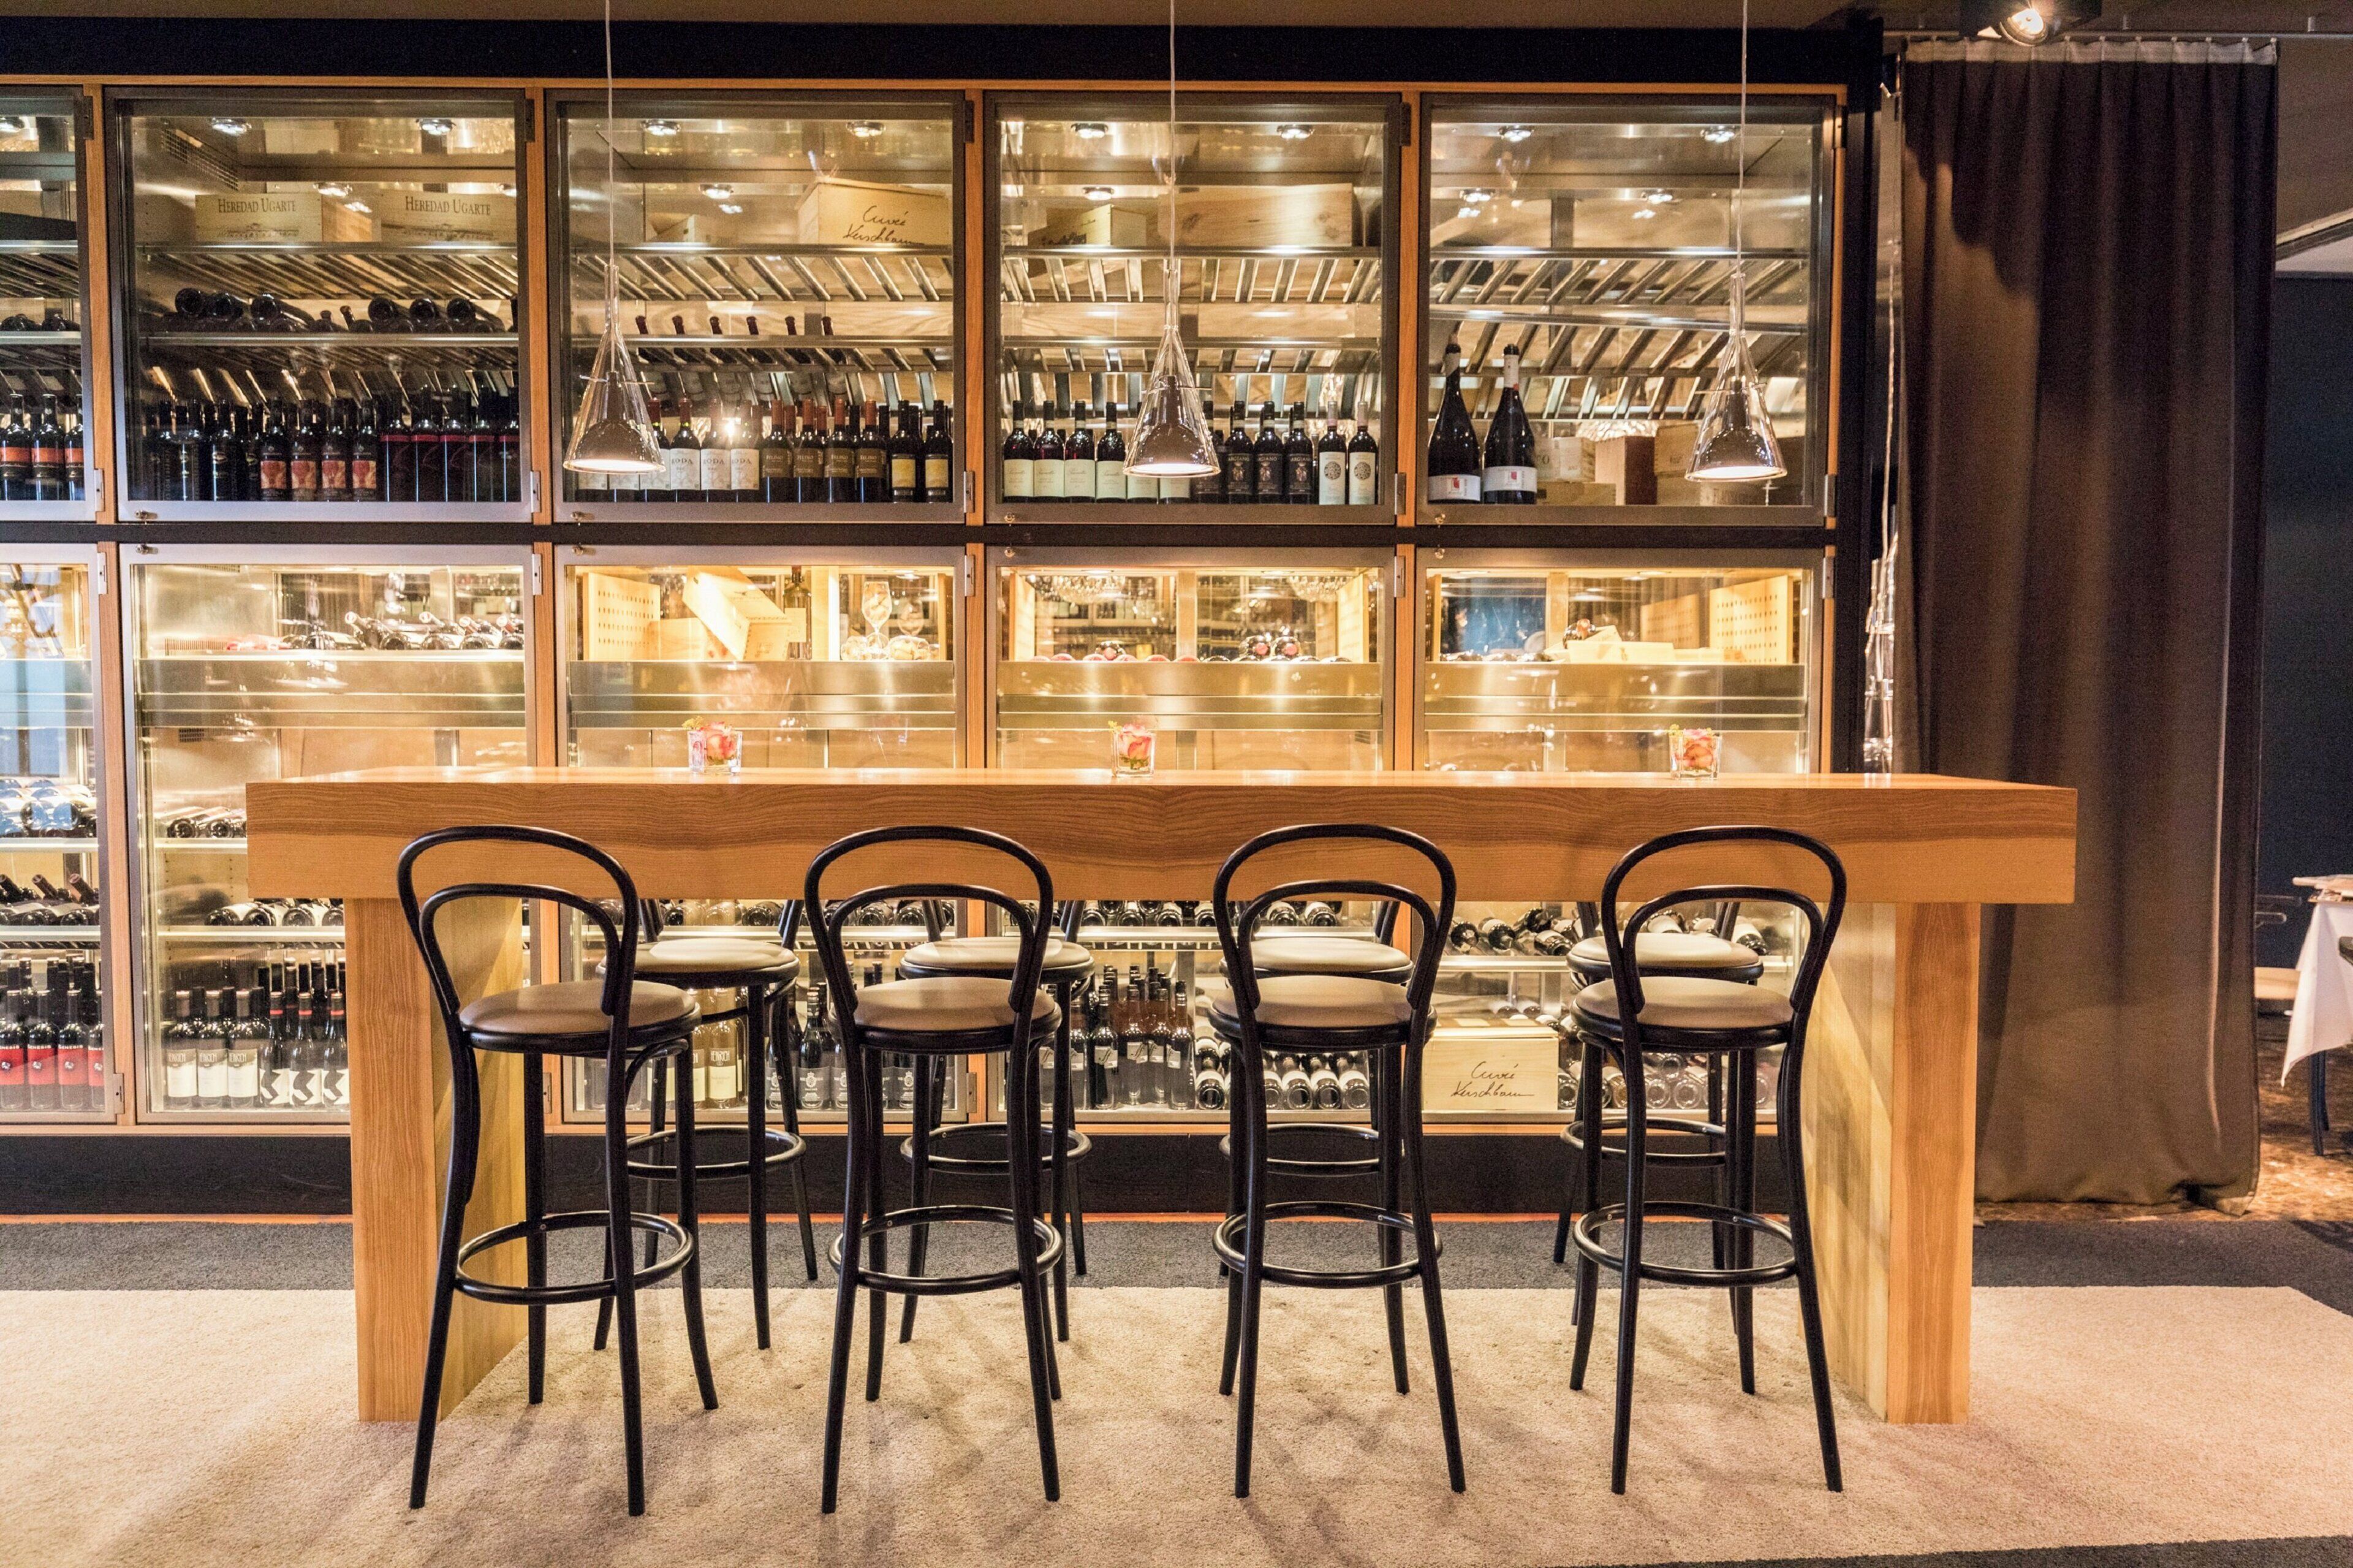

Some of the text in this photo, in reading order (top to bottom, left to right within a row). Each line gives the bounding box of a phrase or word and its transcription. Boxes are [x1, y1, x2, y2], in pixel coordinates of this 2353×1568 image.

[218, 198, 296, 213] HEREDAD UGARTE
[405, 195, 491, 216] HEREDAD UGARTE
